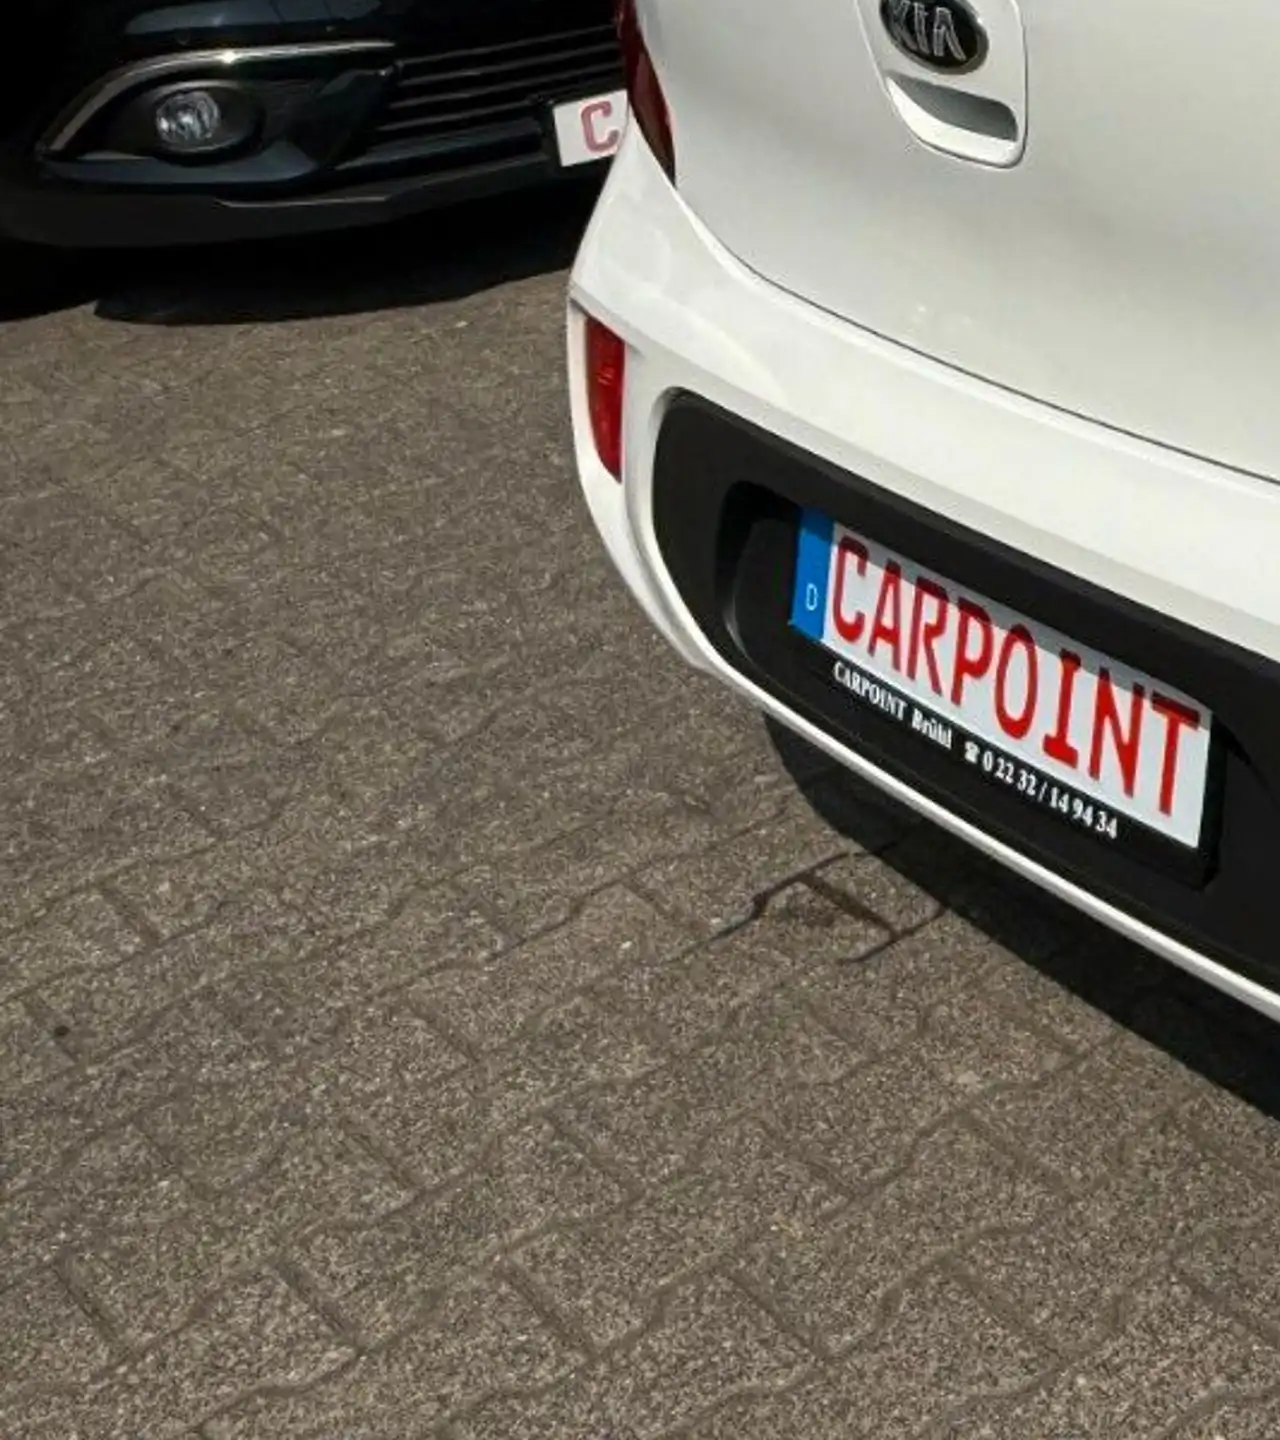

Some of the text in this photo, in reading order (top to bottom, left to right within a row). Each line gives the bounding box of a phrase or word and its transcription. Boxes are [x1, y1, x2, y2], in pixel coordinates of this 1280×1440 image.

[832, 535, 1200, 817] CARPOINT
[834, 660, 907, 721] CARPOINT
[911, 708, 952, 751] Brühl
[995, 755, 1014, 784] 22
[1017, 769, 1037, 796] 32
[1050, 787, 1069, 814] 14
[1073, 797, 1094, 827] 94
[1096, 810, 1118, 839] 34
